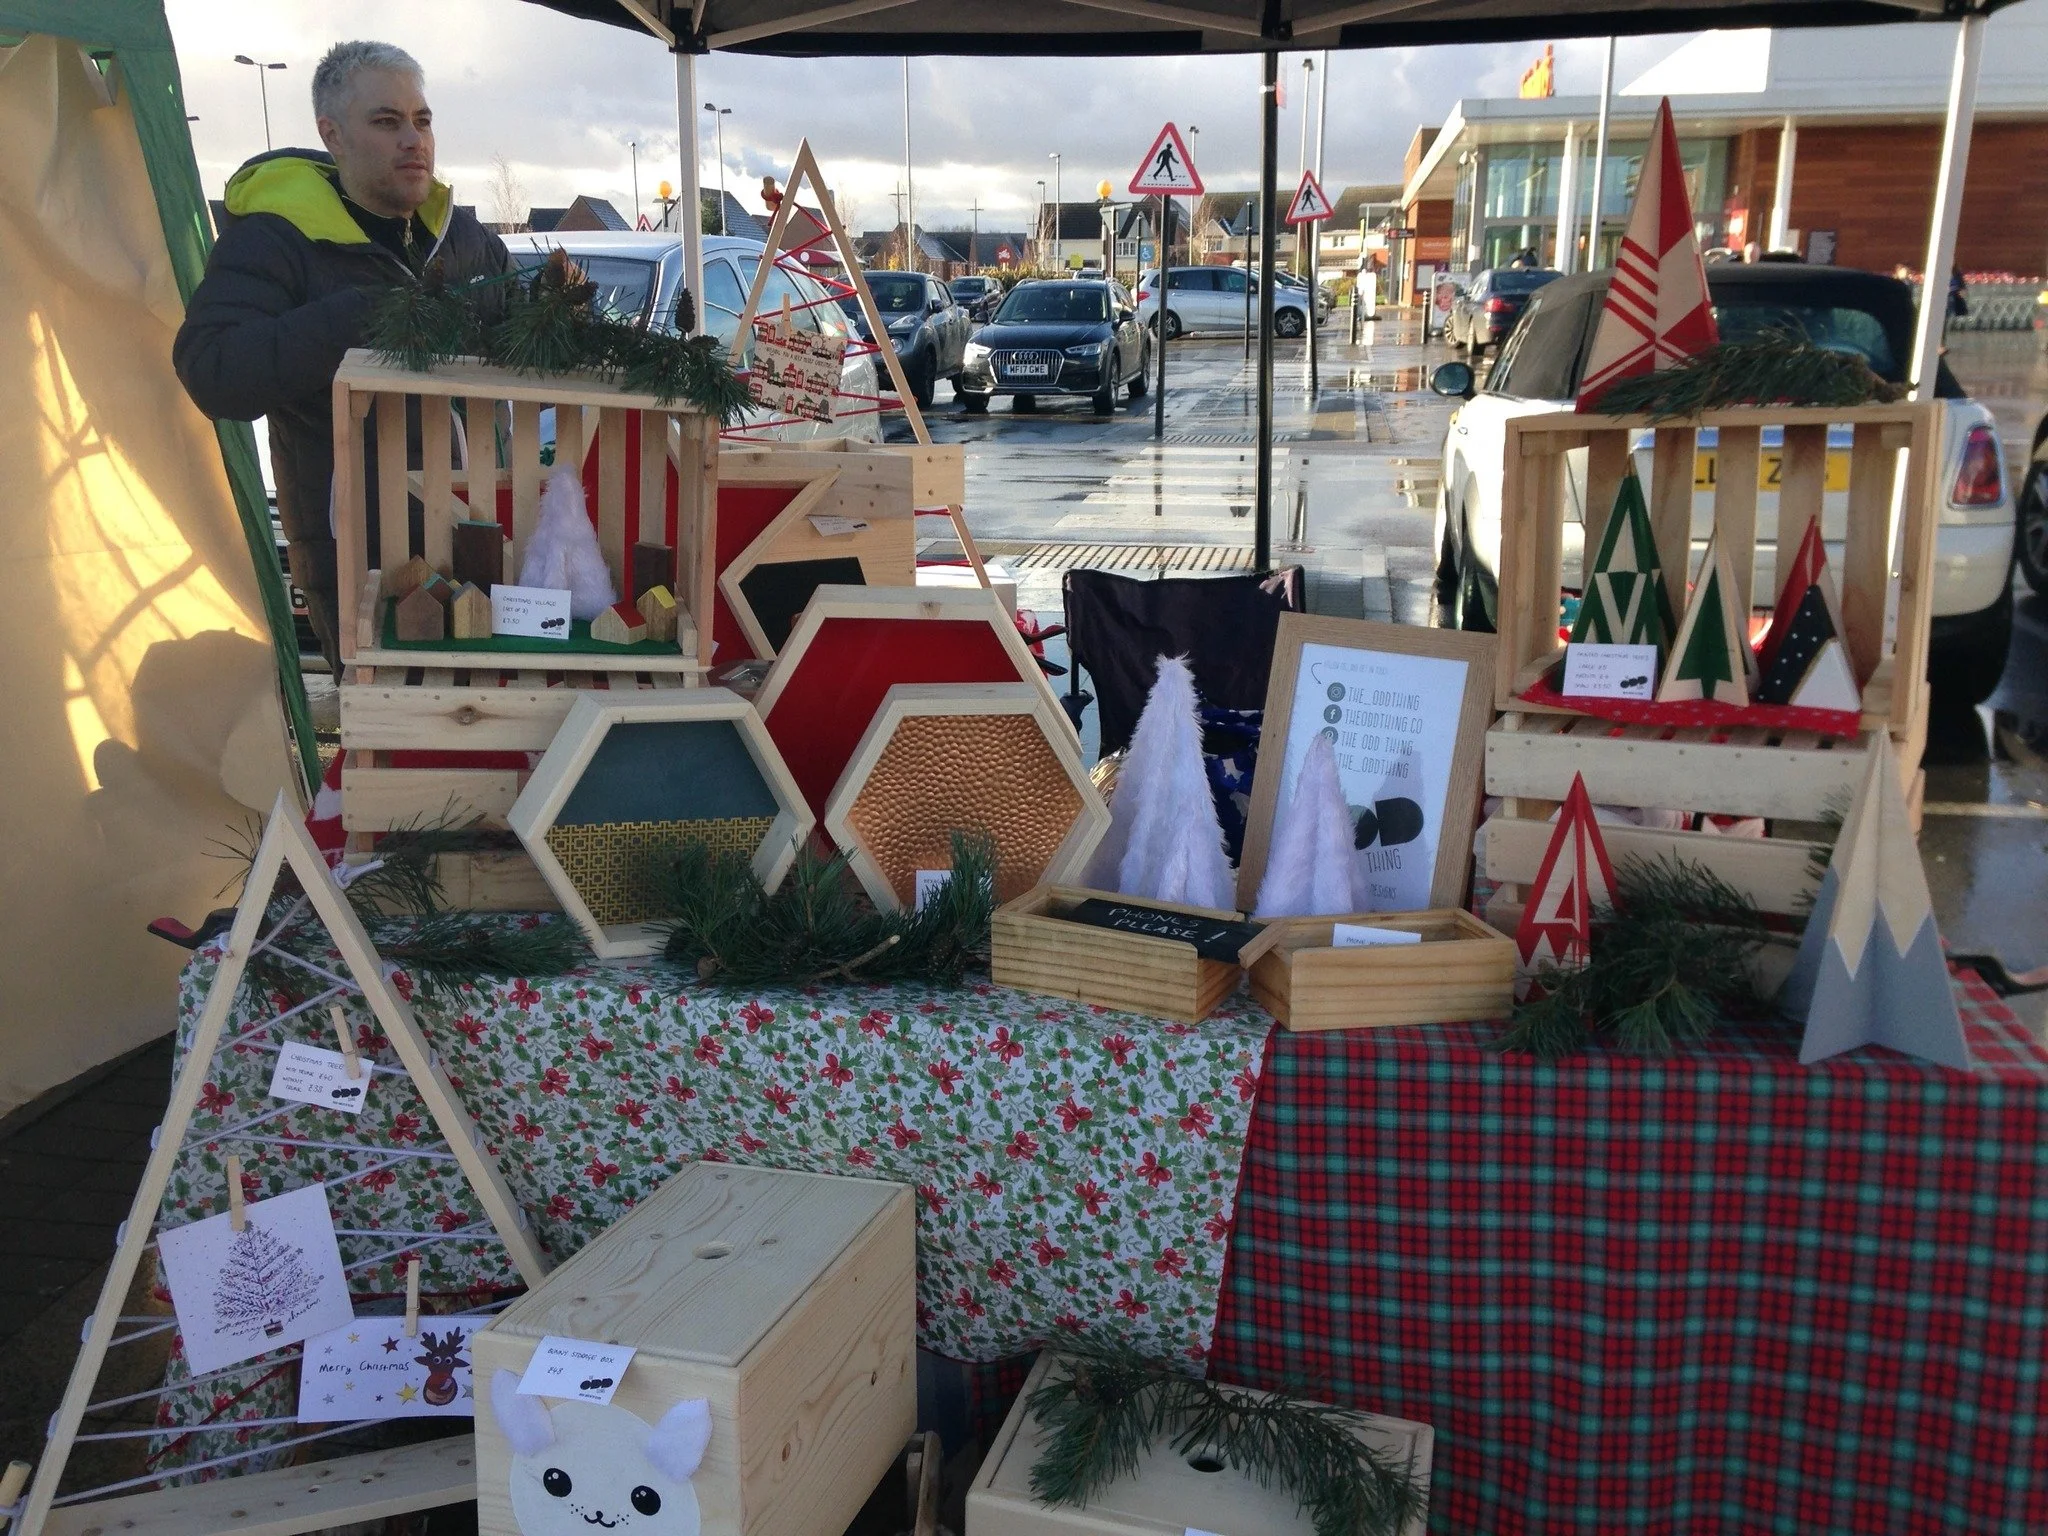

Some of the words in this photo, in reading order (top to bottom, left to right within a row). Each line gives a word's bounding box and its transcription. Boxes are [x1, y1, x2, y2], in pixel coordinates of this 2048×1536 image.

[1029, 365, 1045, 374] GWE
[1341, 731, 1358, 749] THE
[1361, 734, 1380, 750] ODD
[1385, 737, 1414, 756] THING
[1366, 848, 1402, 873] THING
[1108, 908, 1202, 928] PHONES
[1113, 918, 1199, 939] PLEASE
[290, 1053, 323, 1066] CHRISTMAS
[547, 1348, 568, 1357] BUNNY
[571, 1351, 597, 1362] STORAGE
[600, 1356, 615, 1364] BOX
[319, 1364, 352, 1375] Merry
[359, 1360, 410, 1372] Christmas
